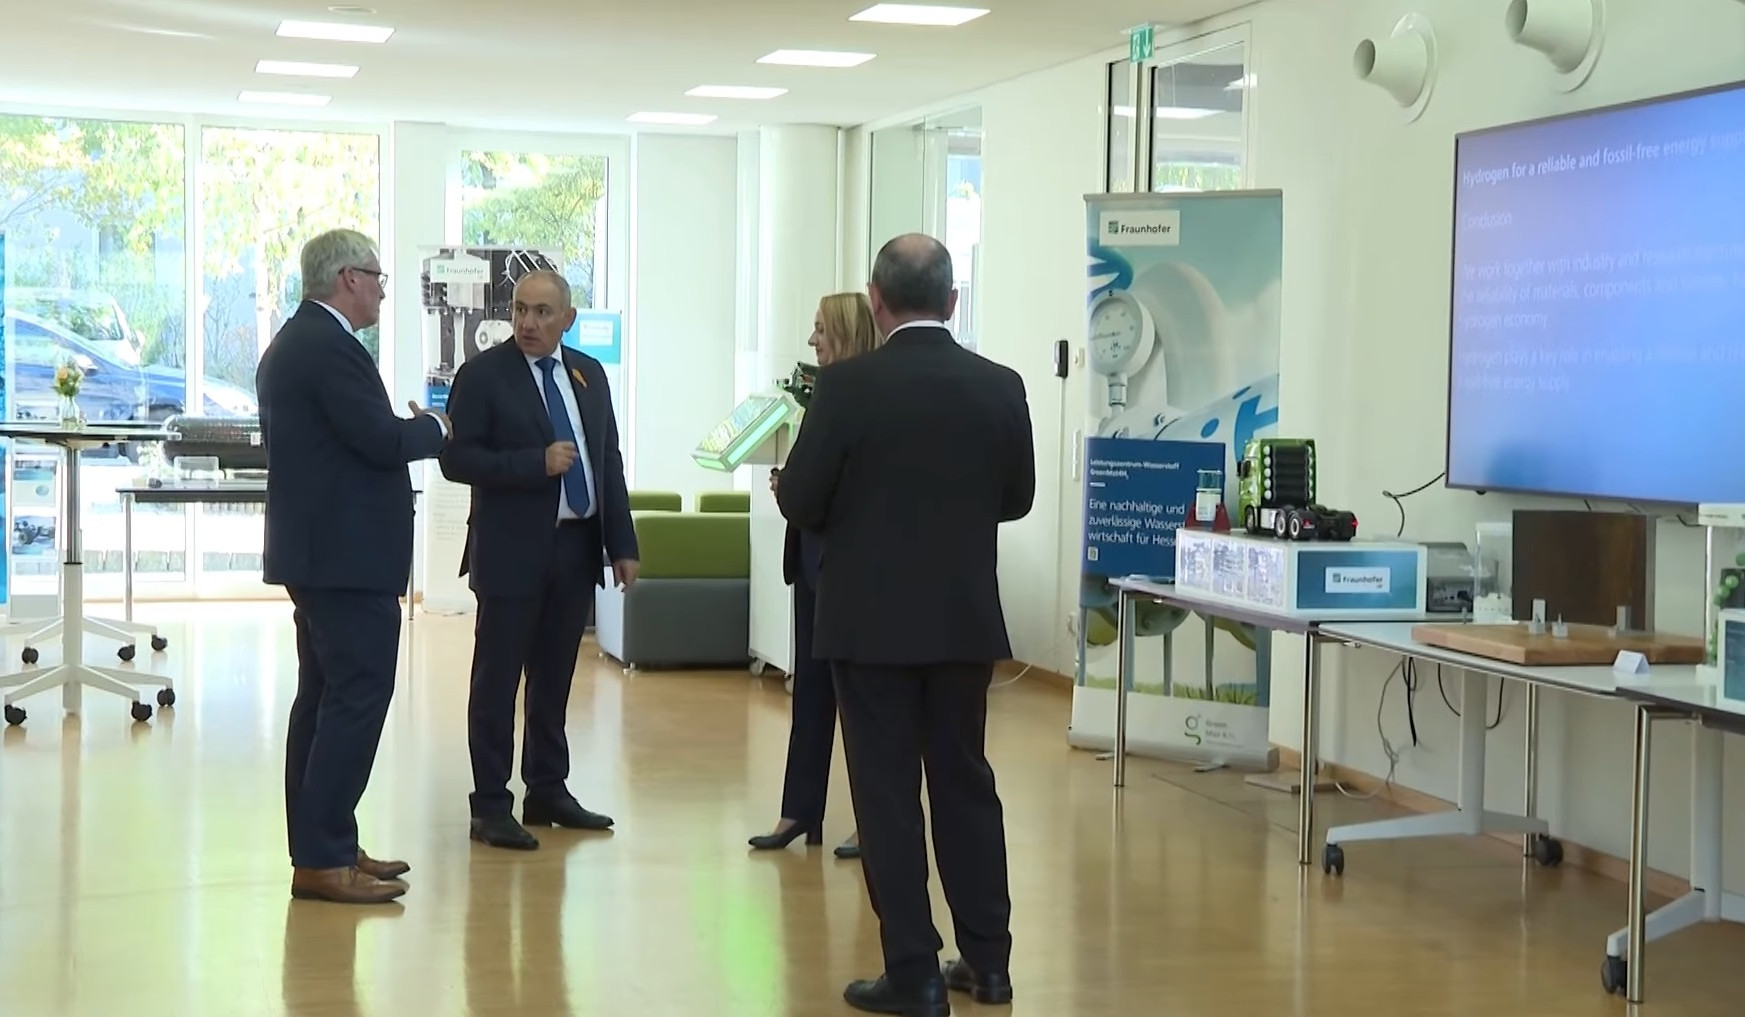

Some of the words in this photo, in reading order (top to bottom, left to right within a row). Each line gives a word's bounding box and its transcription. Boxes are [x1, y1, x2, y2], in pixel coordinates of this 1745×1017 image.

[1463, 168, 1509, 187] Hydrogen
[1511, 161, 1526, 178] for
[1528, 164, 1535, 176] a
[1537, 154, 1576, 175] reliable
[1578, 149, 1600, 169] and
[1603, 142, 1660, 164] fossil-free
[1663, 136, 1707, 156] energy
[1121, 224, 1171, 233] Fraunhofer
[1089, 499, 1106, 509] Eine
[1109, 500, 1163, 516] nachhaltige
[1166, 503, 1185, 514] und
[1088, 515, 1142, 530] zuverlässige
[1087, 530, 1133, 543] wirtschaft
[1136, 532, 1149, 544] für
